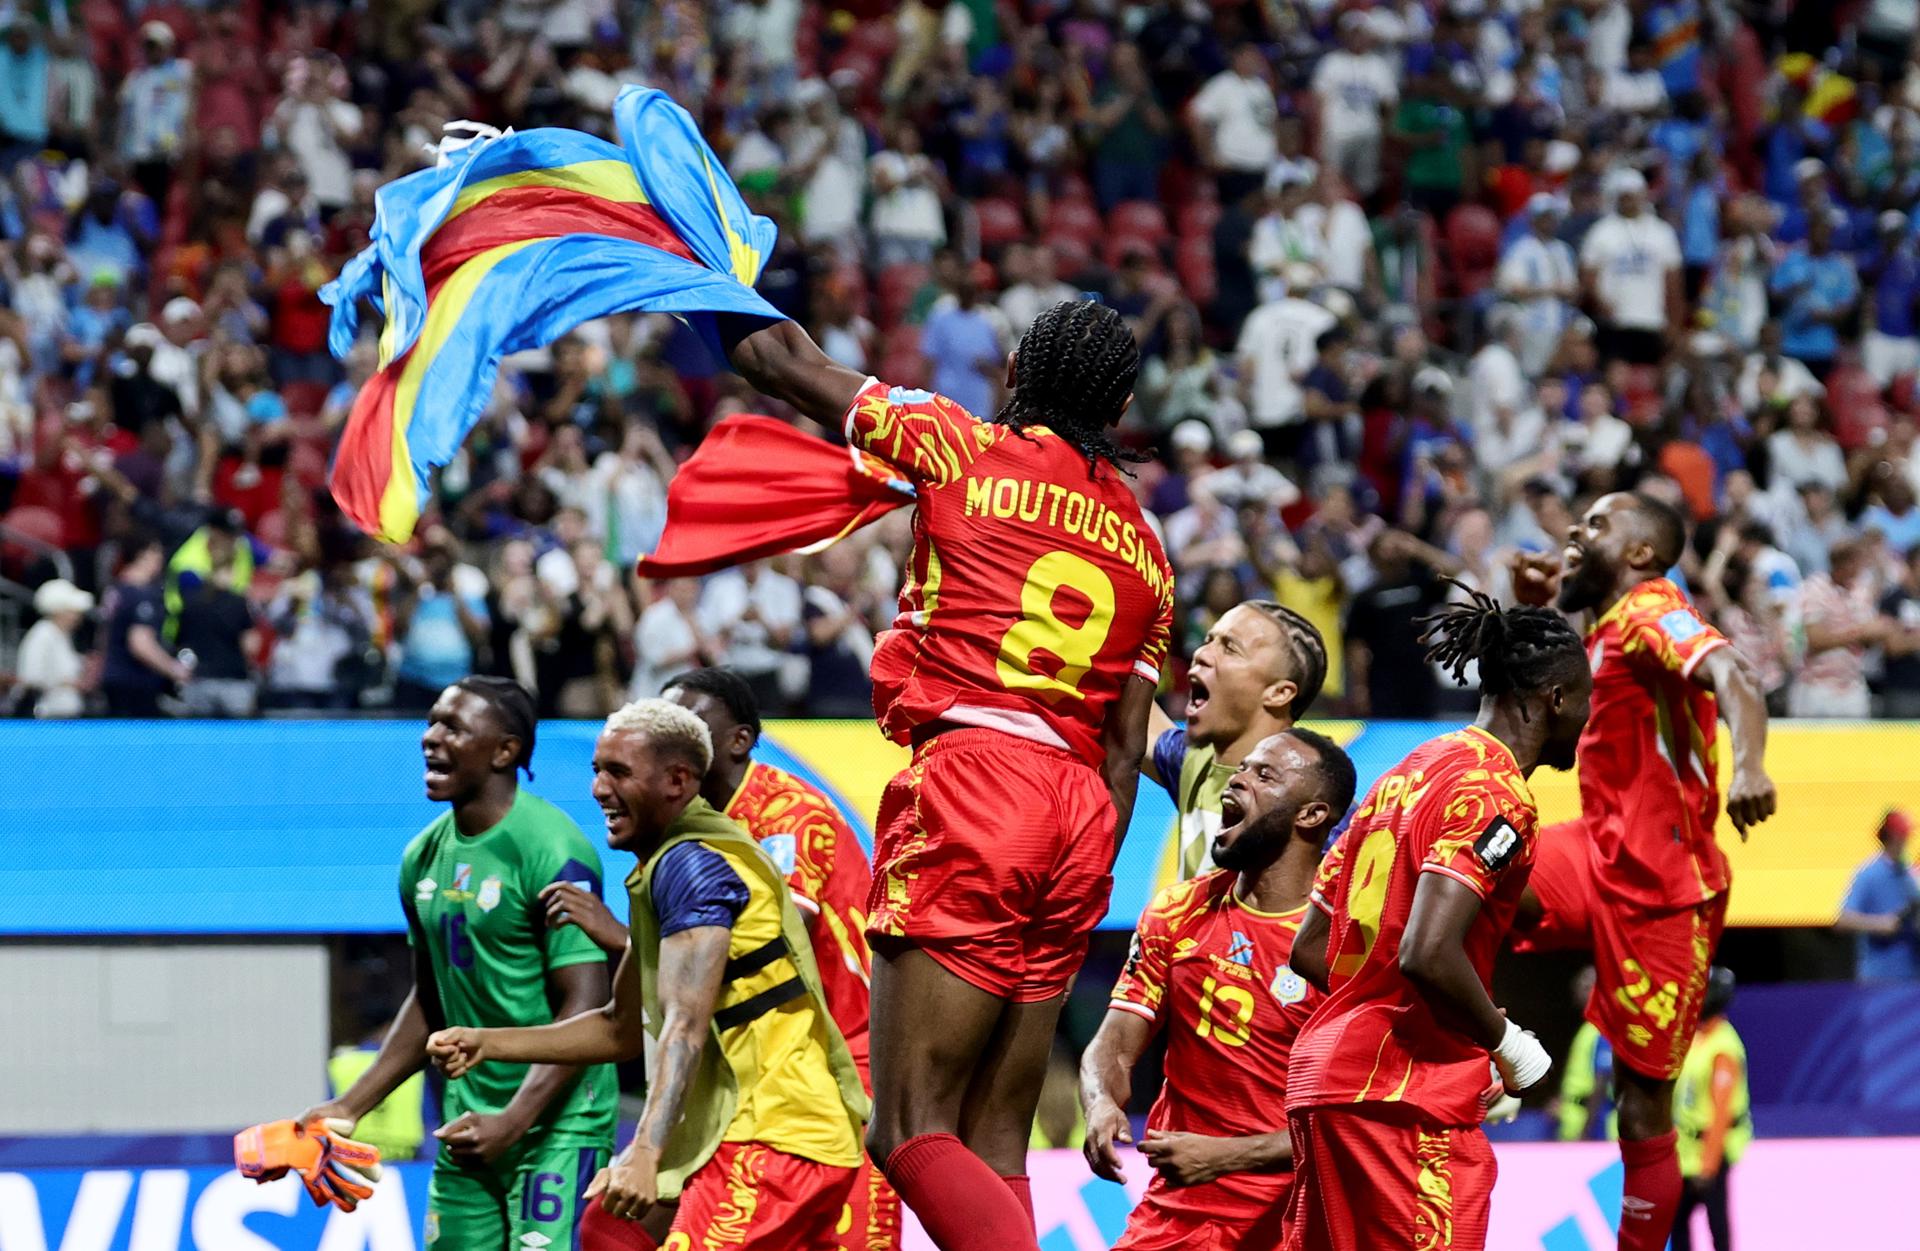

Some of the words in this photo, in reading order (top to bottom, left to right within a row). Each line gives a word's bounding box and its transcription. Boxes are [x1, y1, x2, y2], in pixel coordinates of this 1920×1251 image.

[996, 550, 1116, 702] 8
[1335, 828, 1396, 977] 9
[440, 911, 475, 970] 16
[1196, 976, 1255, 1047] 13
[1615, 958, 1677, 1030] 24
[520, 1172, 565, 1223] 16
